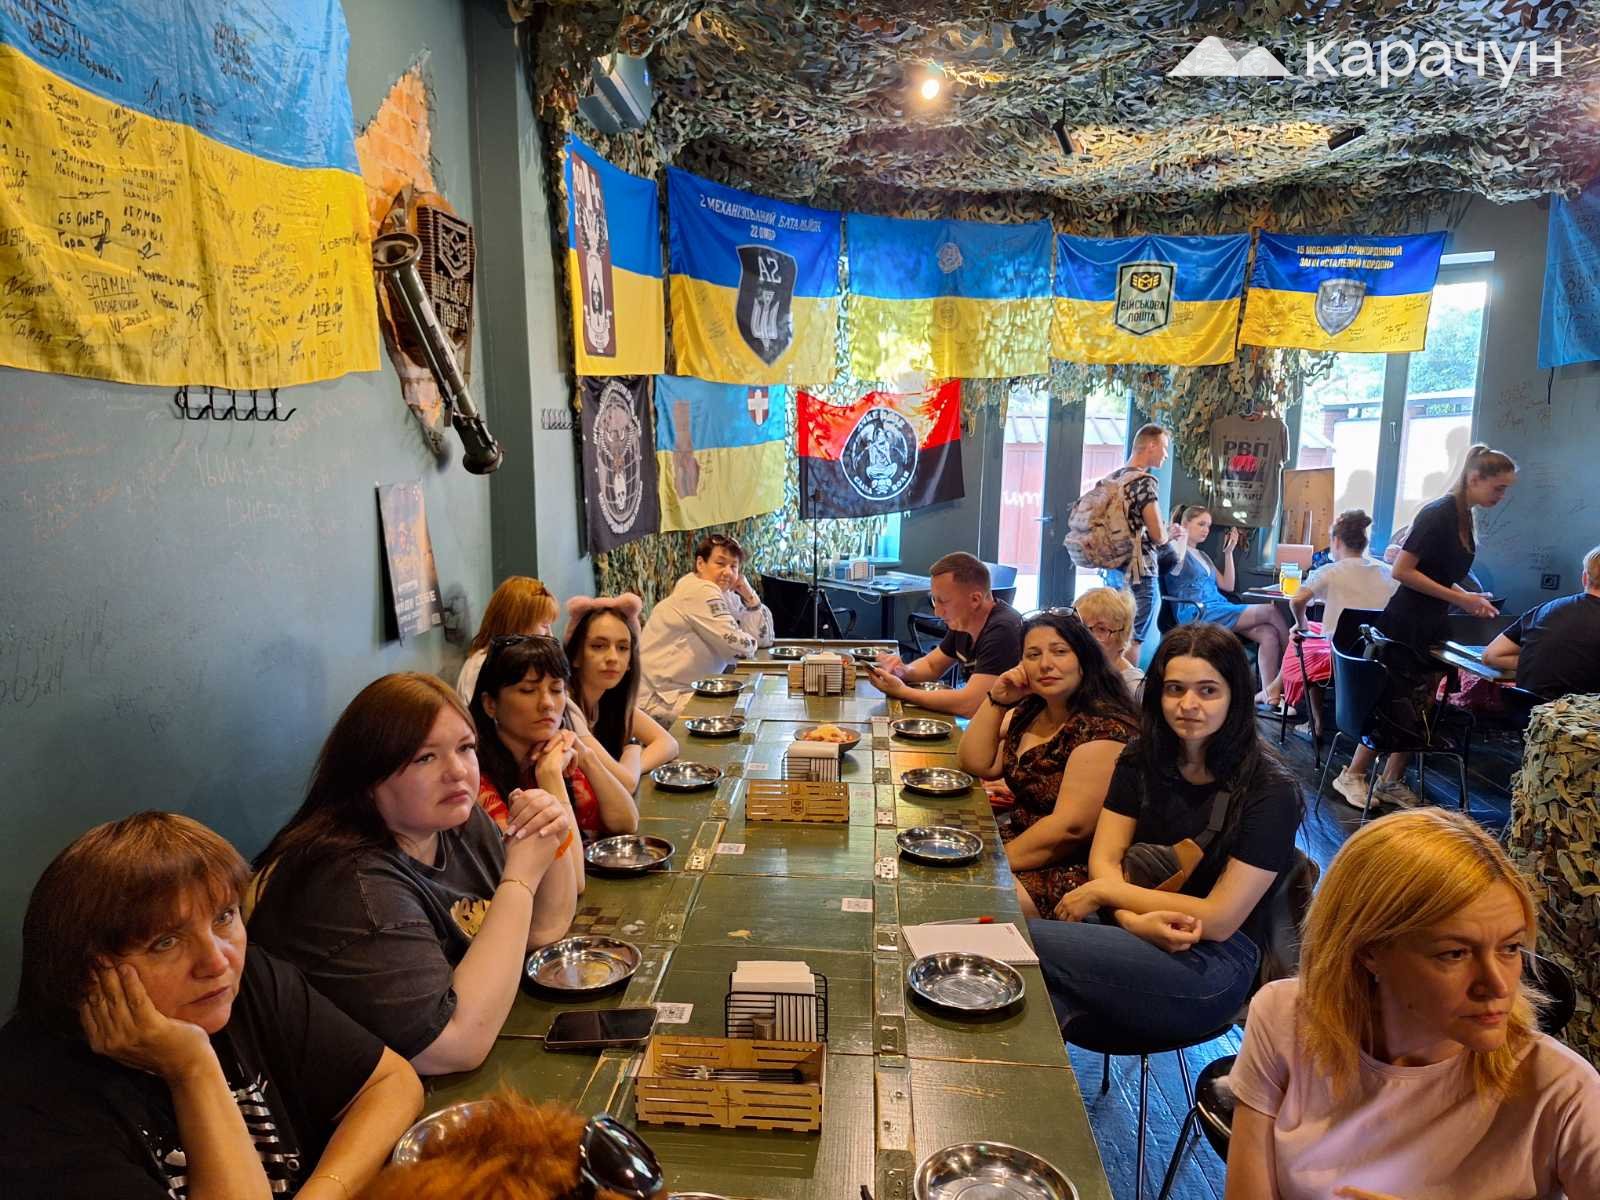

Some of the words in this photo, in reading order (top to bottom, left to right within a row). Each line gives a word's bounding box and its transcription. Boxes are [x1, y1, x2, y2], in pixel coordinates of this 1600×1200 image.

[699, 194, 707, 208] 2
[1120, 299, 1166, 313] ВІЙСЬКОВА
[1128, 311, 1157, 325] ПОШТА
